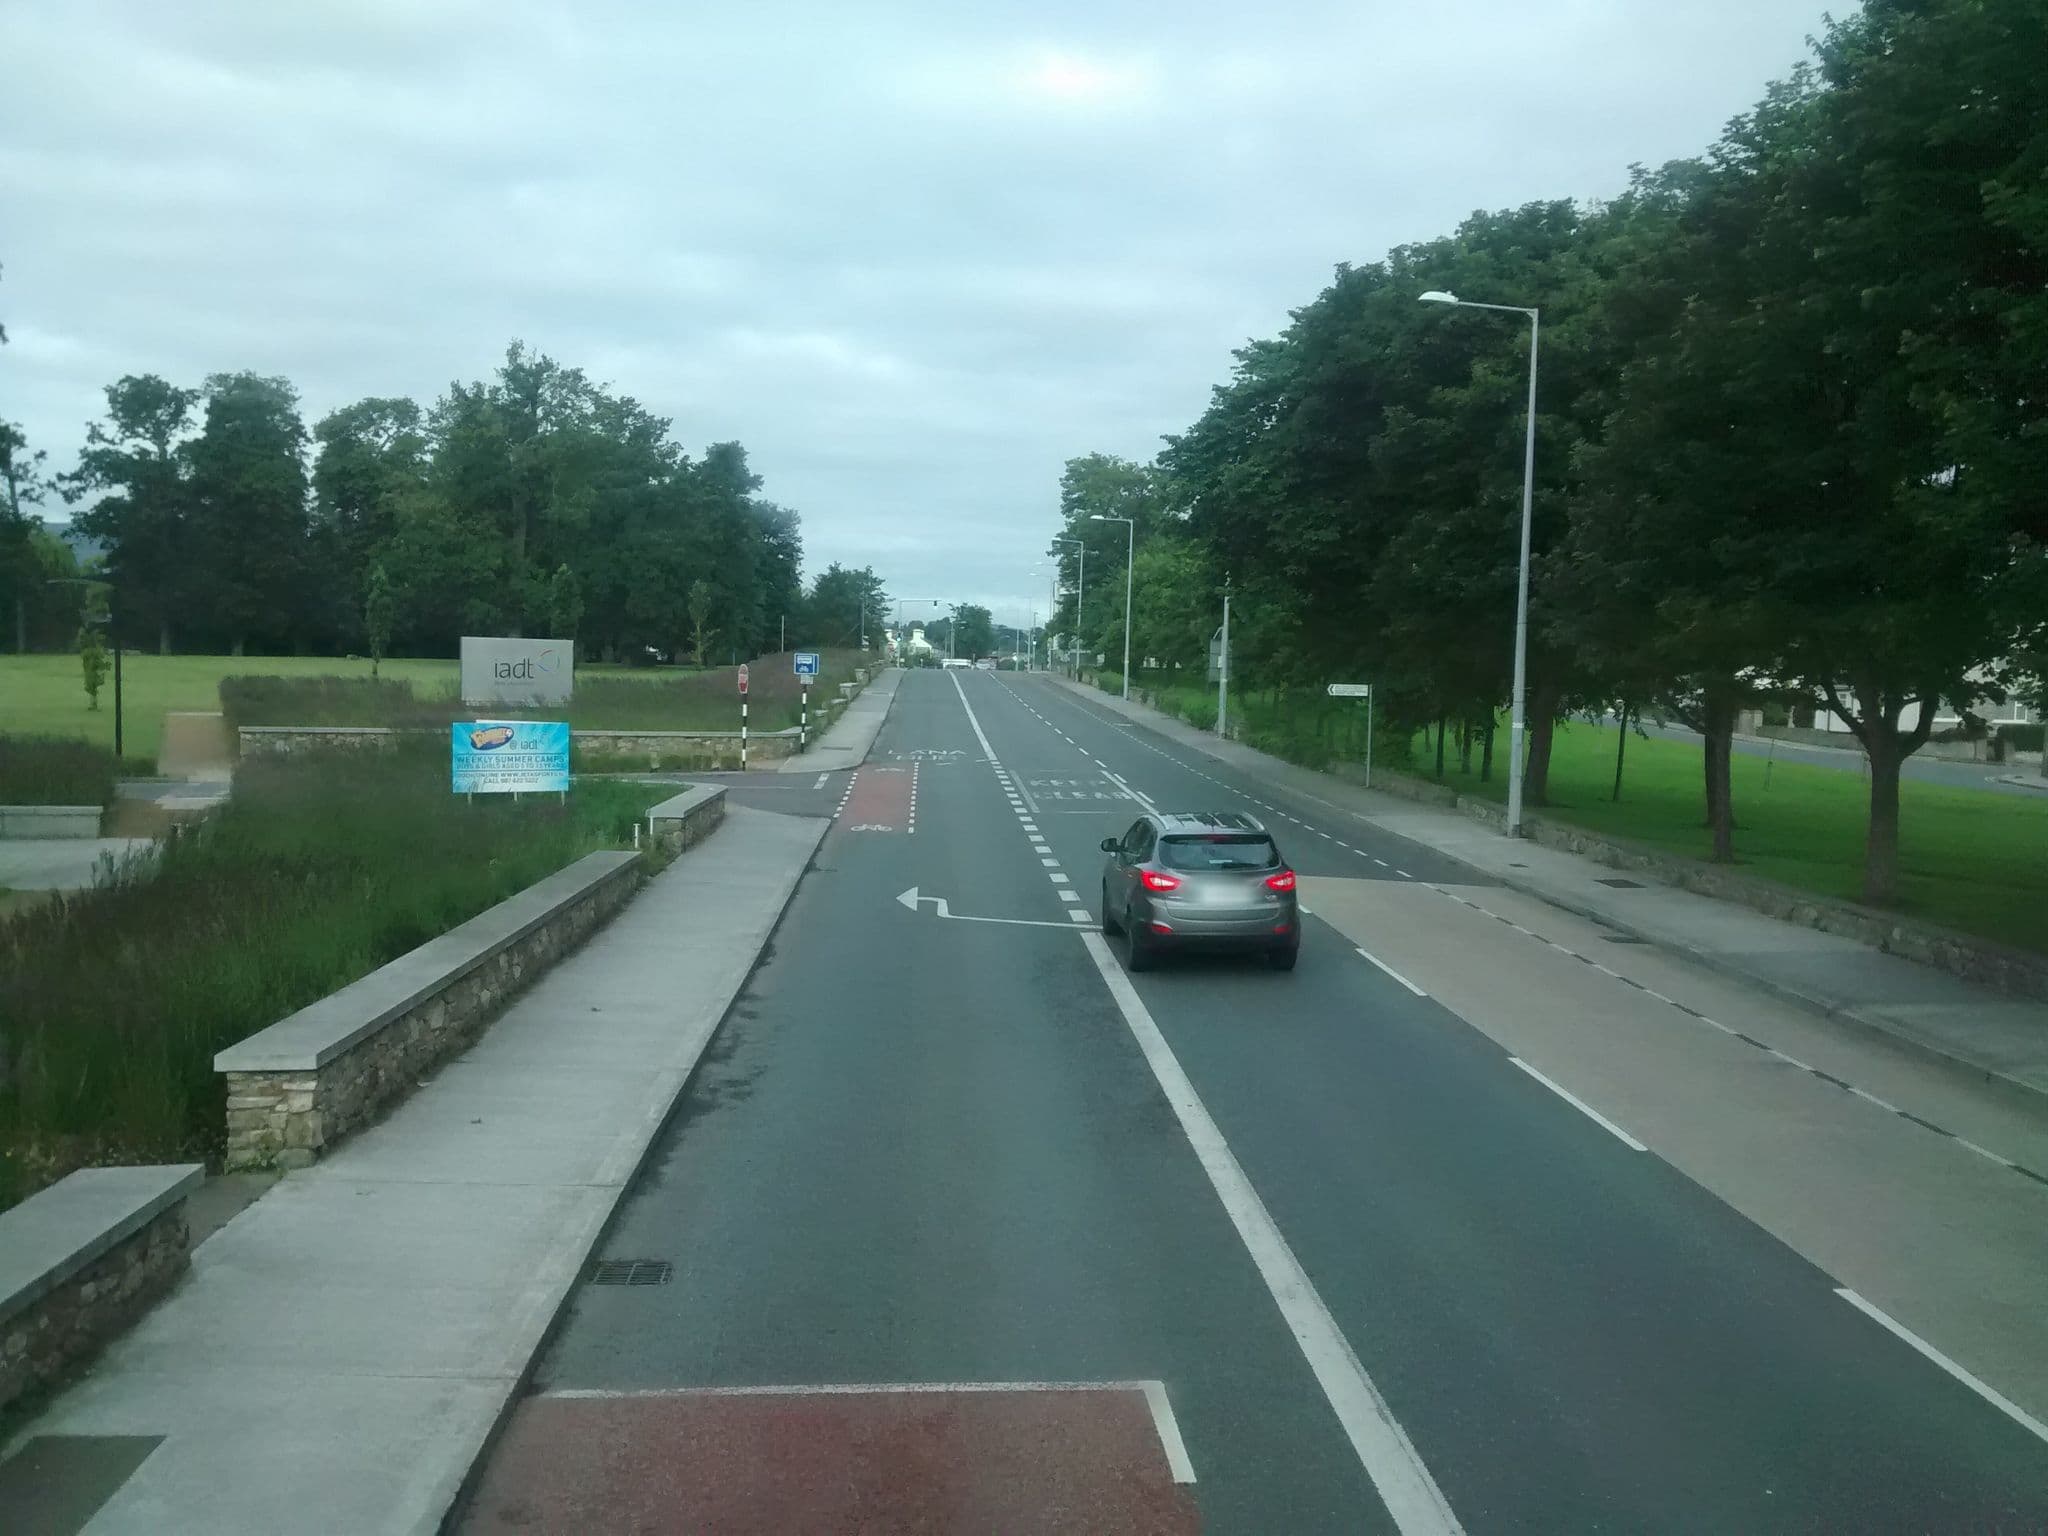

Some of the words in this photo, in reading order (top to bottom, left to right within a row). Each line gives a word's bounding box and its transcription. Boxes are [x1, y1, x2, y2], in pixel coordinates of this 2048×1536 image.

[494, 657, 534, 679] iadt
[534, 755, 564, 763] CAMPS
[1031, 791, 1132, 799] CLEAR
